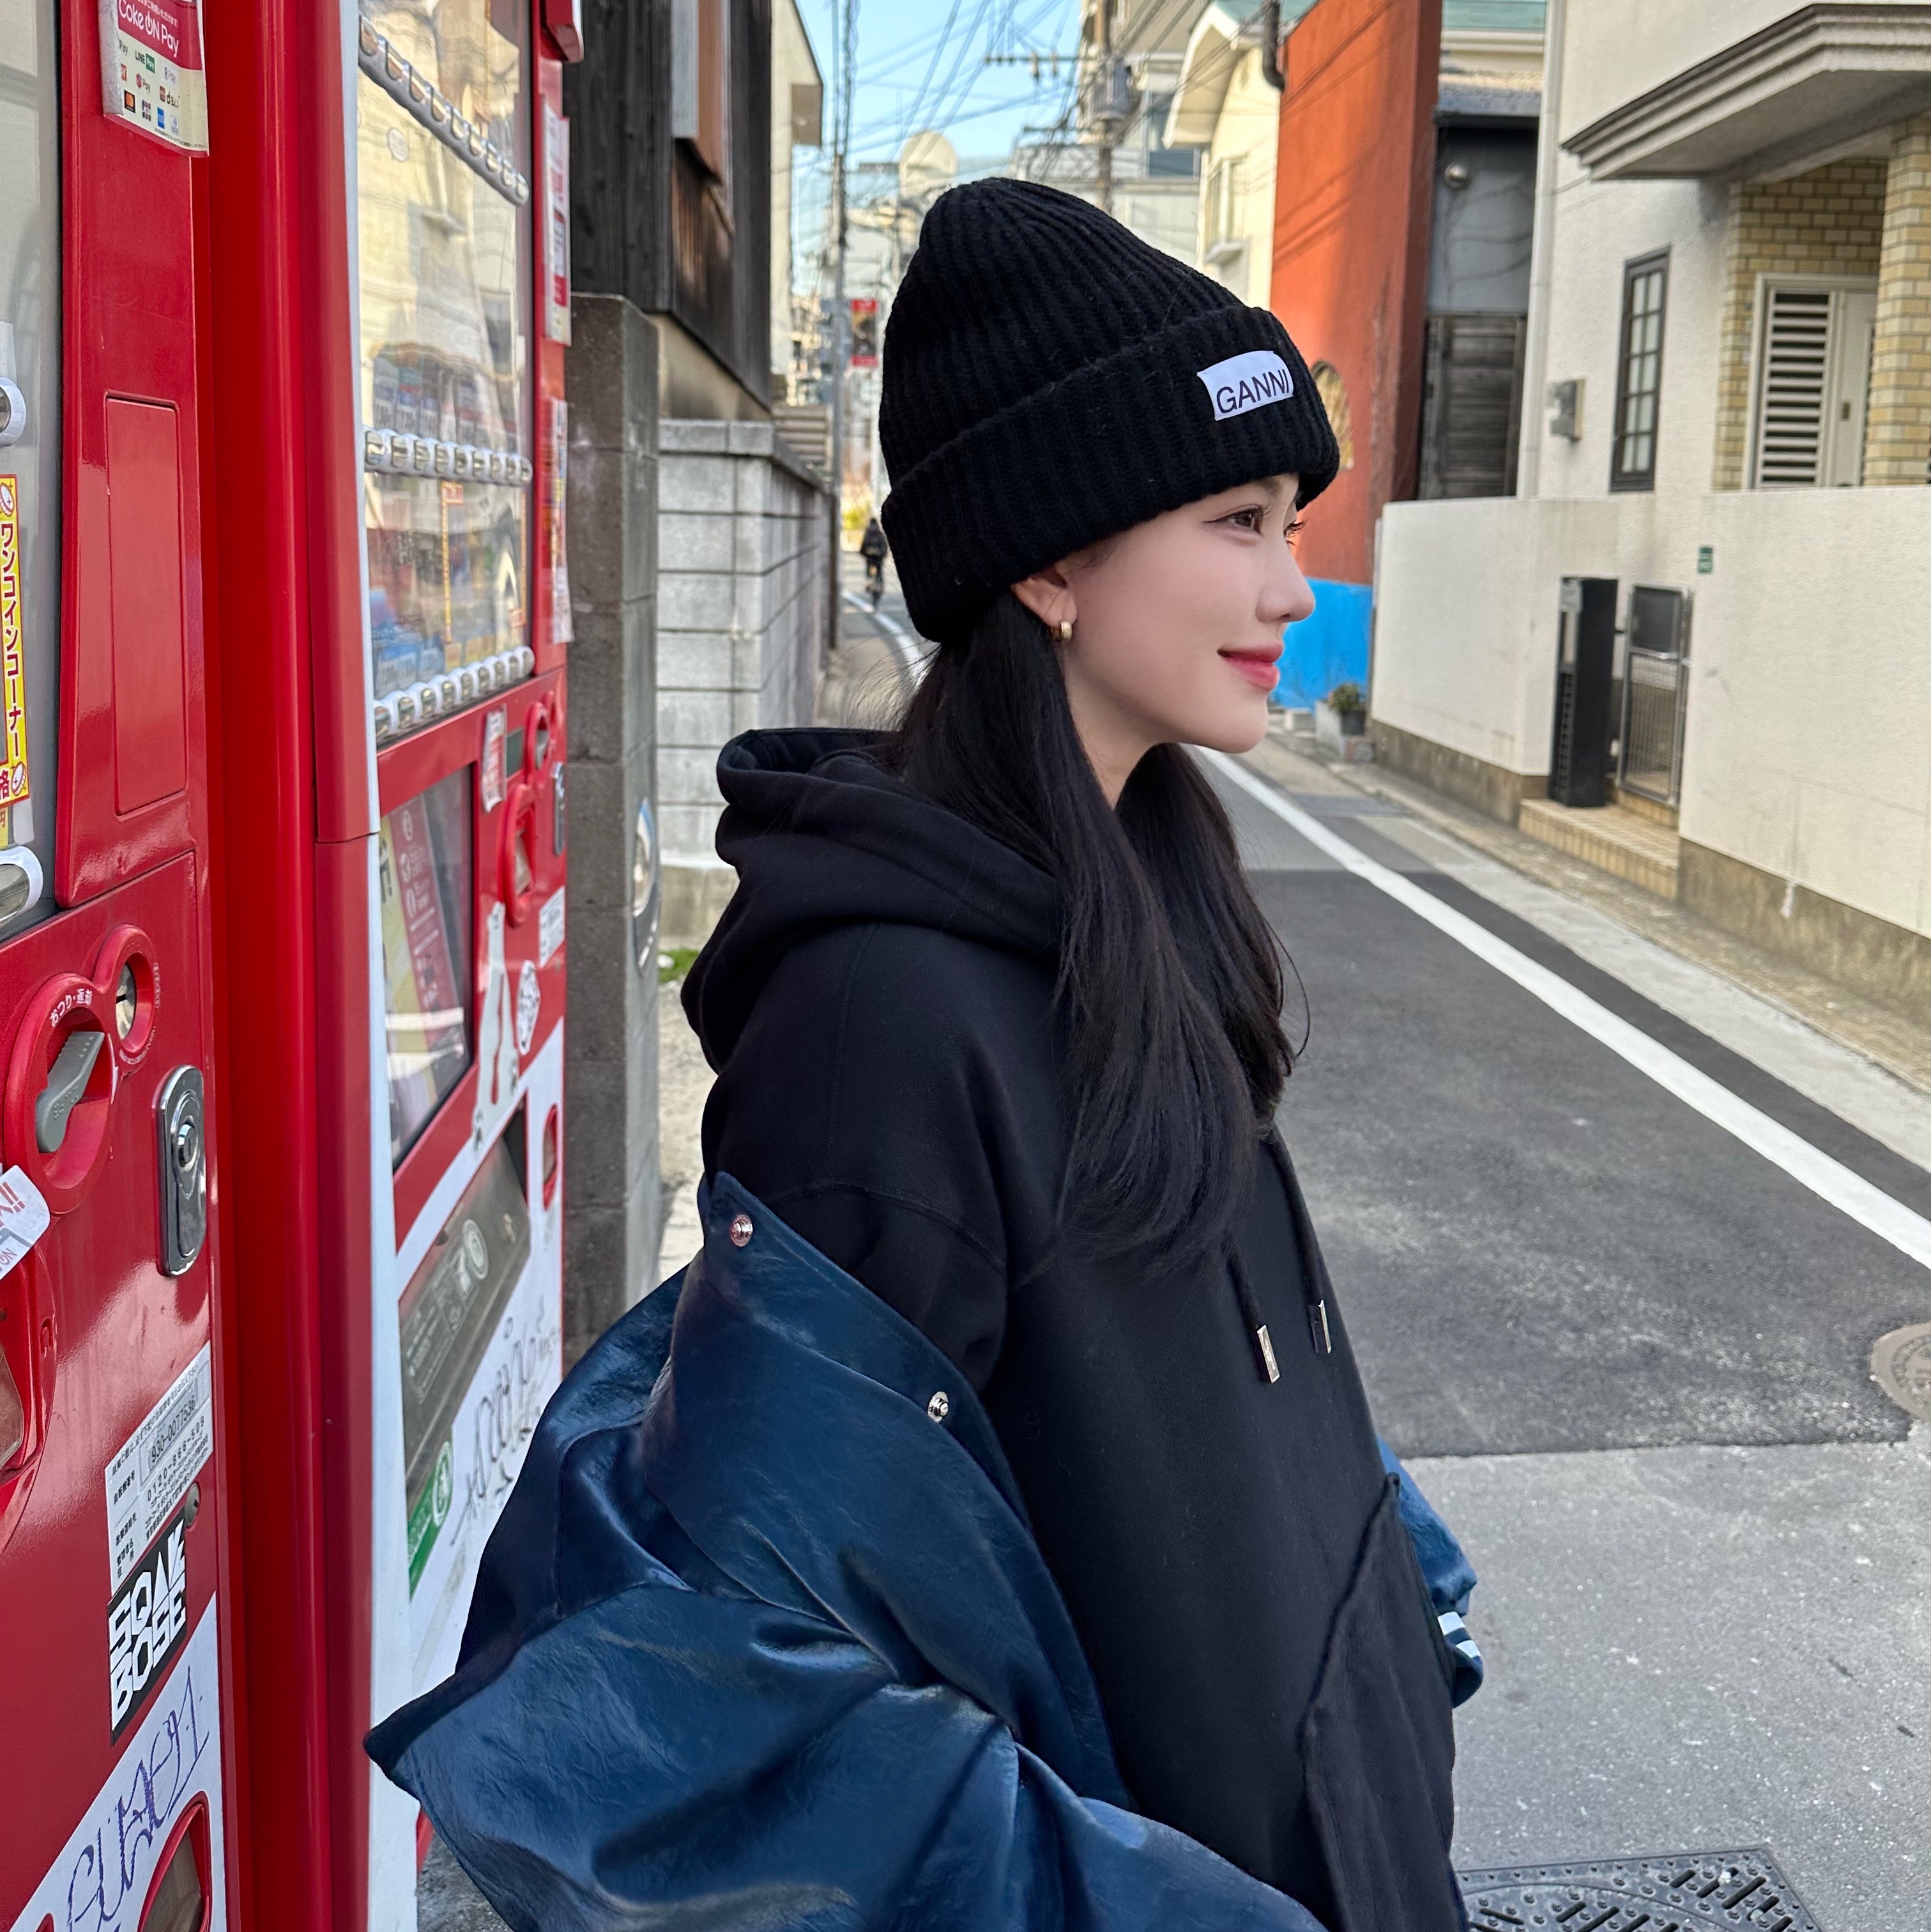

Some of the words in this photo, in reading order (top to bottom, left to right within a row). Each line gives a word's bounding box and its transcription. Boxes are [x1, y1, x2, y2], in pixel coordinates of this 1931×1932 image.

[119, 0, 144, 30] Coke
[145, 11, 160, 41] ON
[161, 26, 179, 58] Pay
[1216, 369, 1290, 414] GANNI
[1, 522, 22, 758] ワンコインコーナー
[111, 1571, 186, 1731] BOSE
